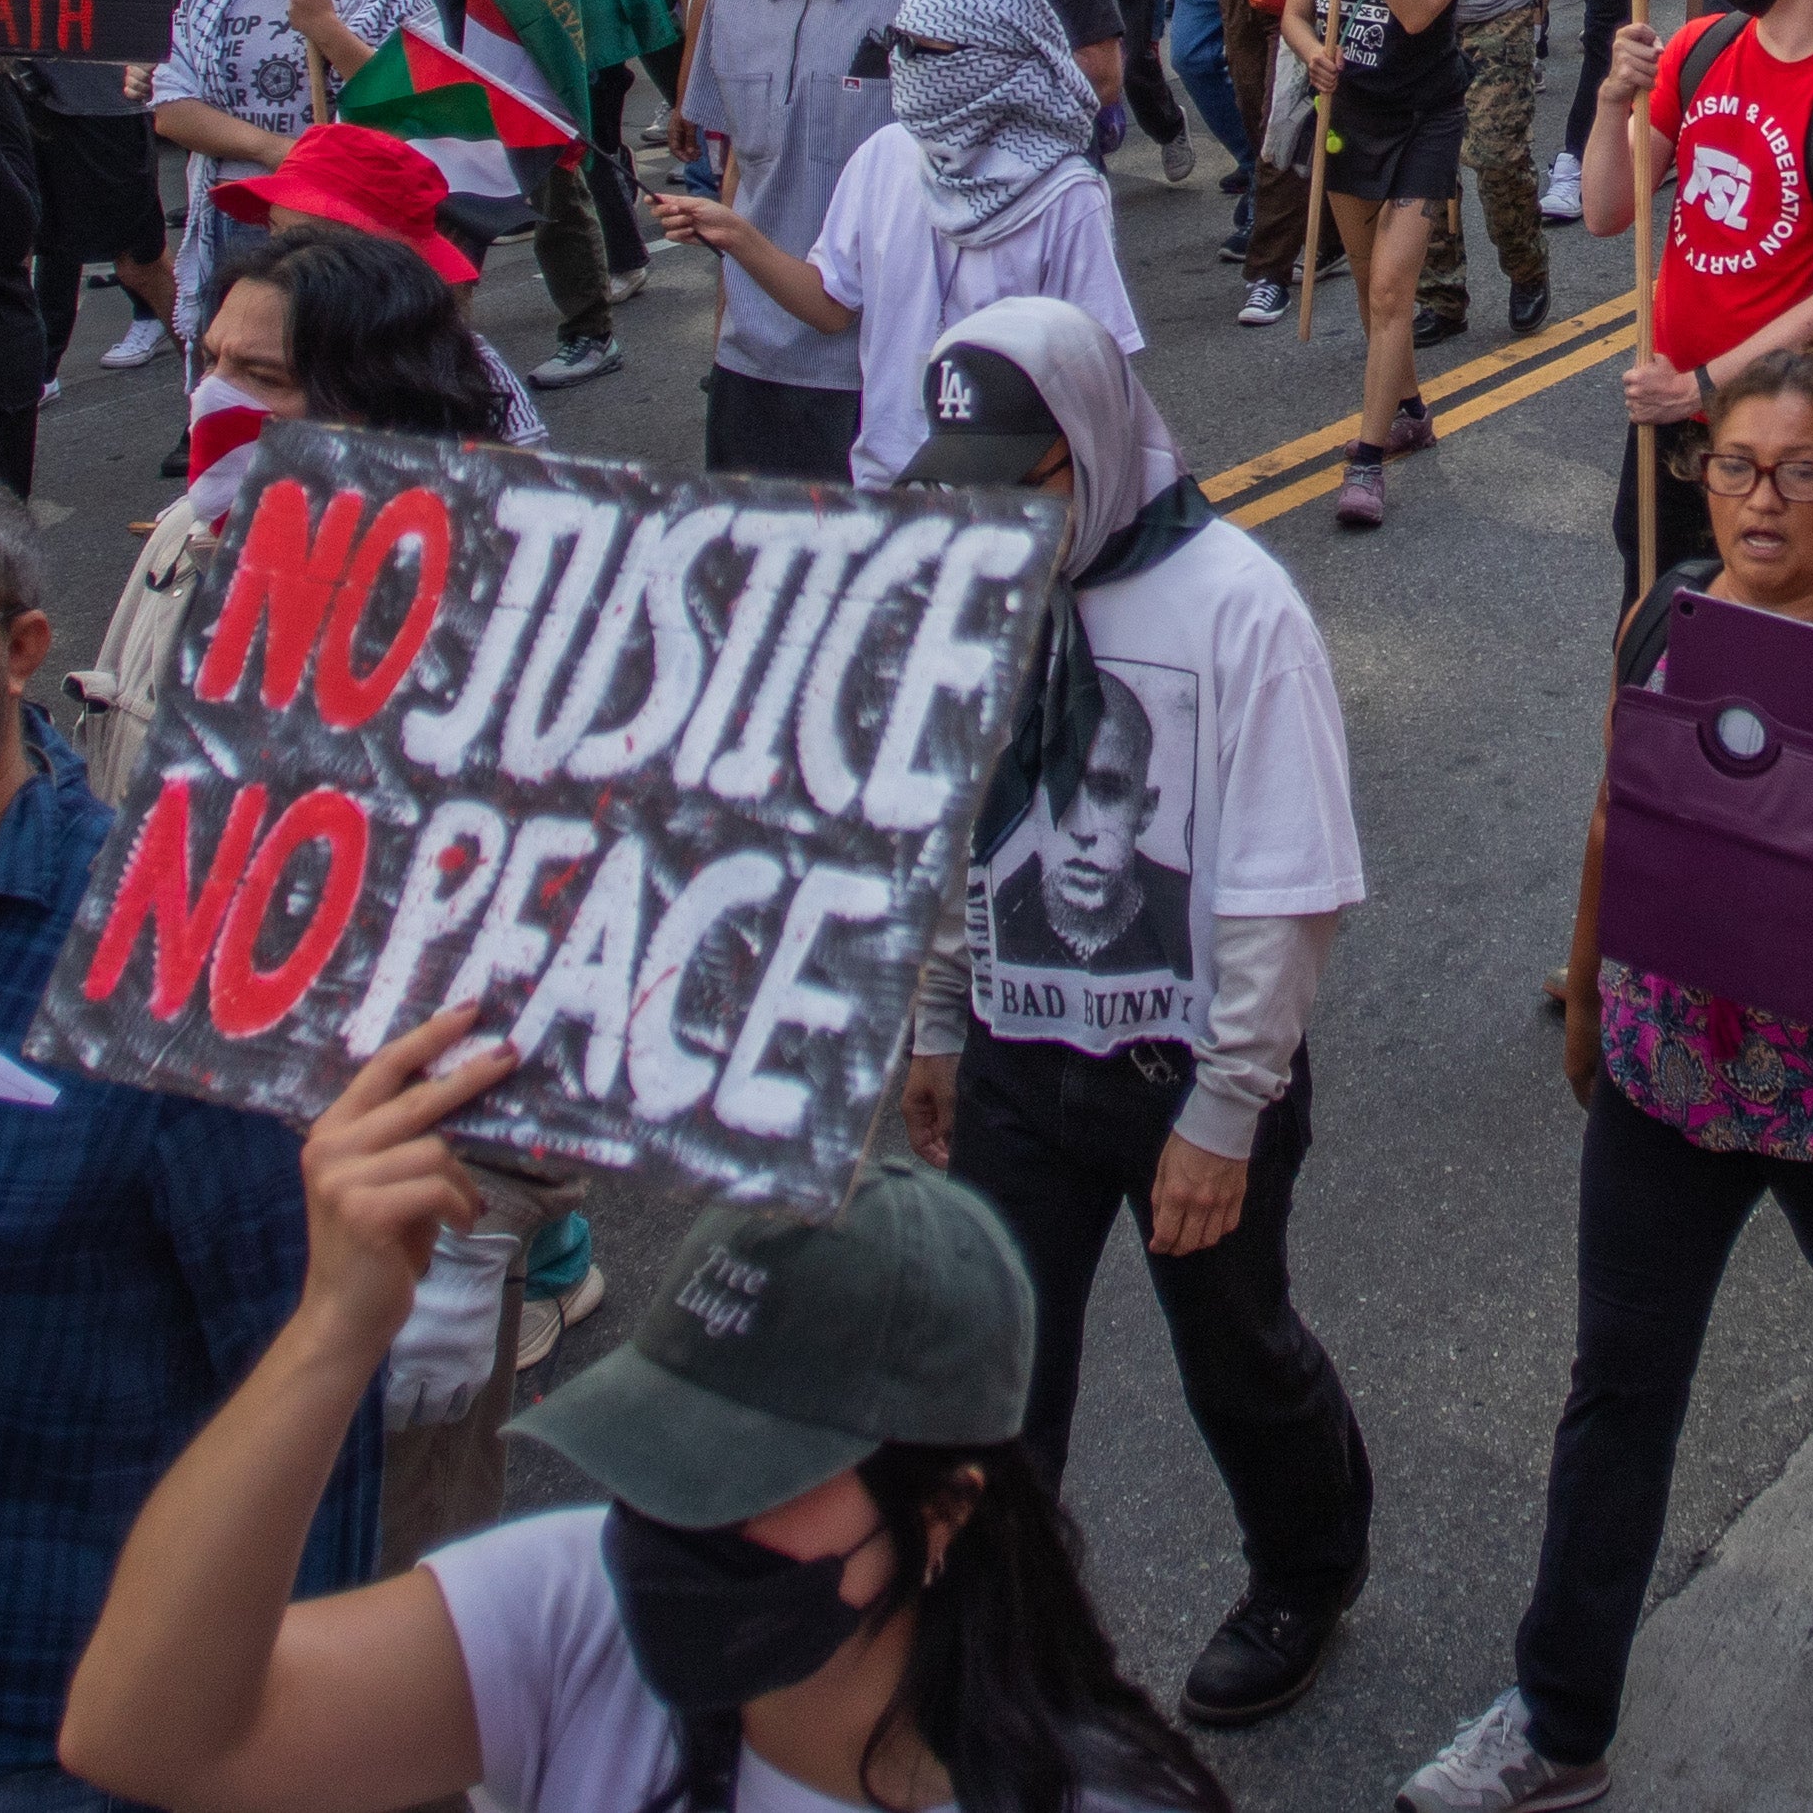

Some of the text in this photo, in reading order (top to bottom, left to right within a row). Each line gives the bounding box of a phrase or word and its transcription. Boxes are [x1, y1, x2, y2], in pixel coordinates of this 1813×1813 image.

[1684, 114, 1802, 276] LIBERATION PARTY
[193, 476, 1037, 833] NO JUSTICE
[80, 778, 893, 1139] NO PEACE
[999, 977, 1067, 1022] BAD
[675, 1276, 759, 1340] Luigi
[692, 1245, 770, 1295] Free
